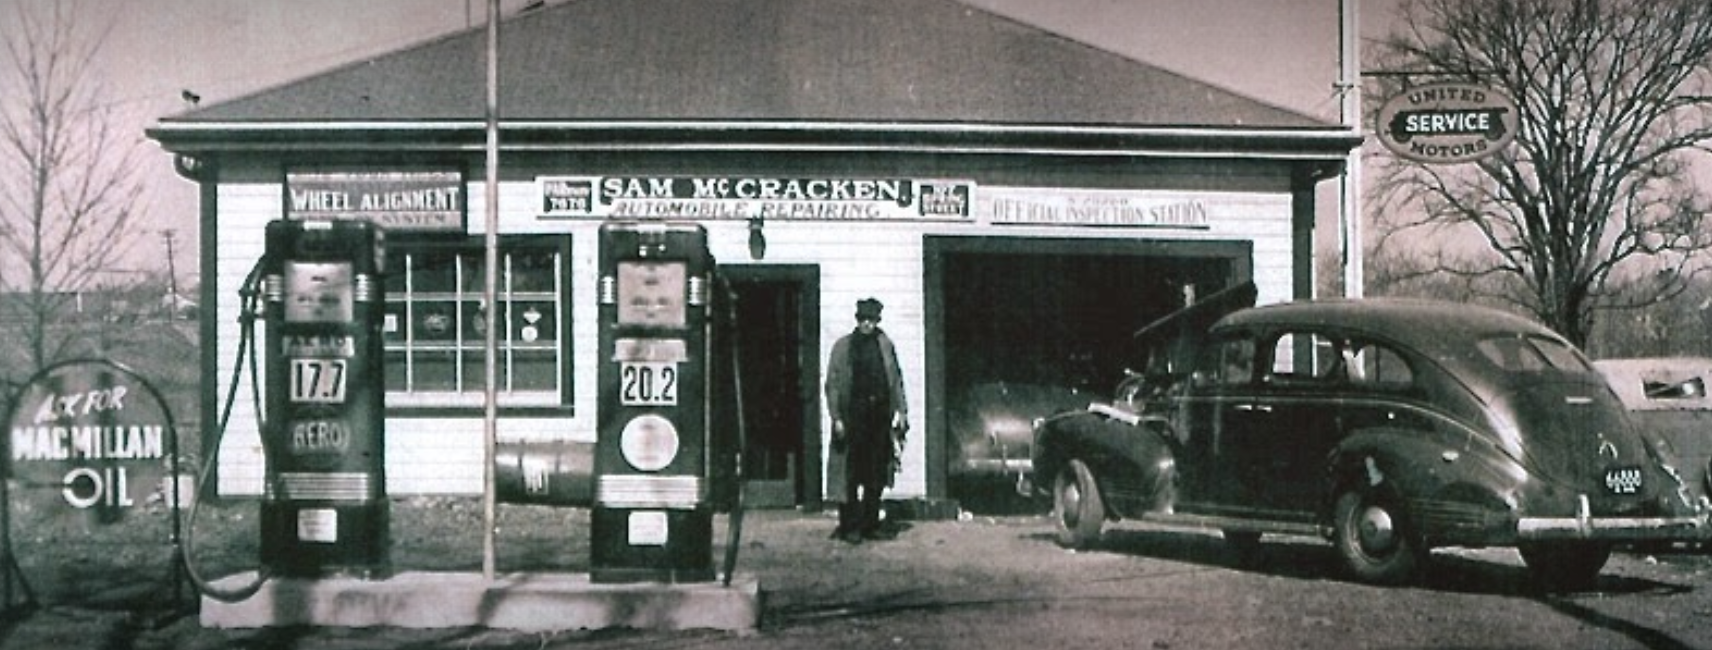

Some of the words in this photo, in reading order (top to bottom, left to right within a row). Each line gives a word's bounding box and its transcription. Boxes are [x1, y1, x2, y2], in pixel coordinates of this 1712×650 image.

[1408, 87, 1486, 104] UNITED
[1405, 113, 1489, 132] SERVICE
[1410, 139, 1487, 157] MOTORS
[289, 188, 354, 211] WHEEL
[360, 187, 459, 211] ALIGNMENT
[603, 178, 674, 199] SAM
[613, 199, 748, 218] AUTOMOBILE
[993, 198, 1061, 221] OFFICIAL
[1066, 204, 1143, 223] INSPECTION
[1150, 201, 1208, 223] STATION
[296, 364, 344, 397] 17.7
[624, 366, 676, 401] 20.2
[82, 385, 127, 415] FOR
[11, 425, 163, 460] MACMILLAN
[61, 466, 134, 508] OIL
